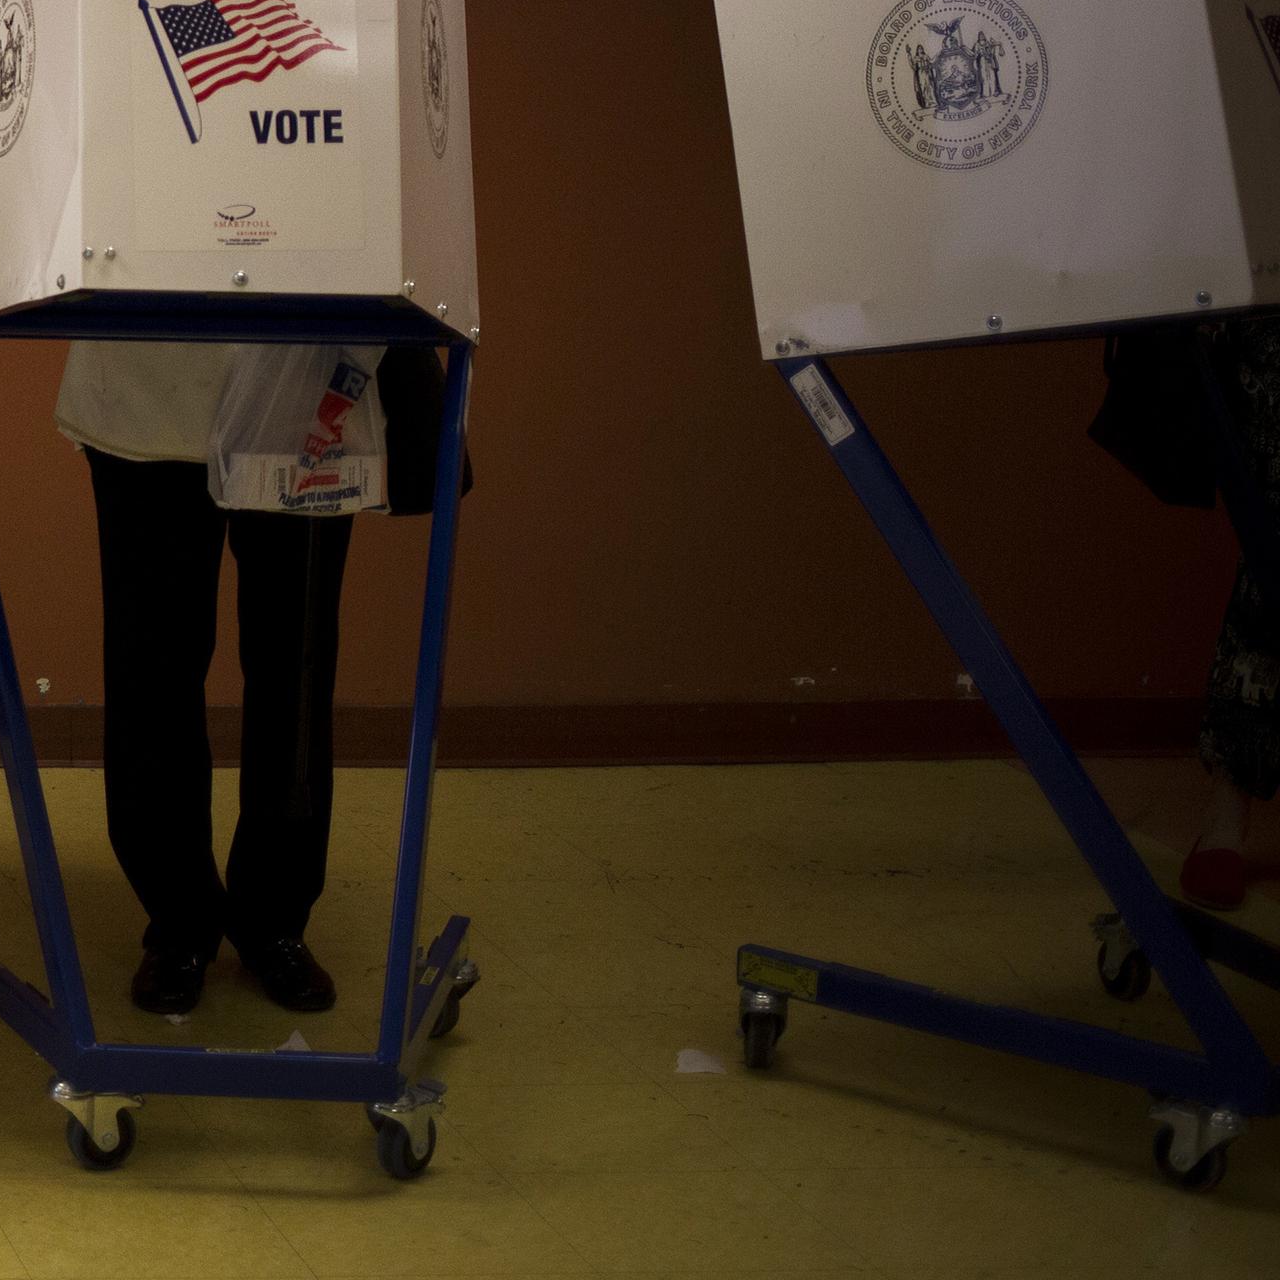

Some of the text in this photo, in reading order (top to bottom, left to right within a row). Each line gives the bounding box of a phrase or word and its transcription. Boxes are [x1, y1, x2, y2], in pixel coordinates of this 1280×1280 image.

[876, 10, 913, 66] BOARD
[249, 109, 344, 144] VOTE
[877, 62, 1038, 159] IN THE CITY OF NEW YORK
